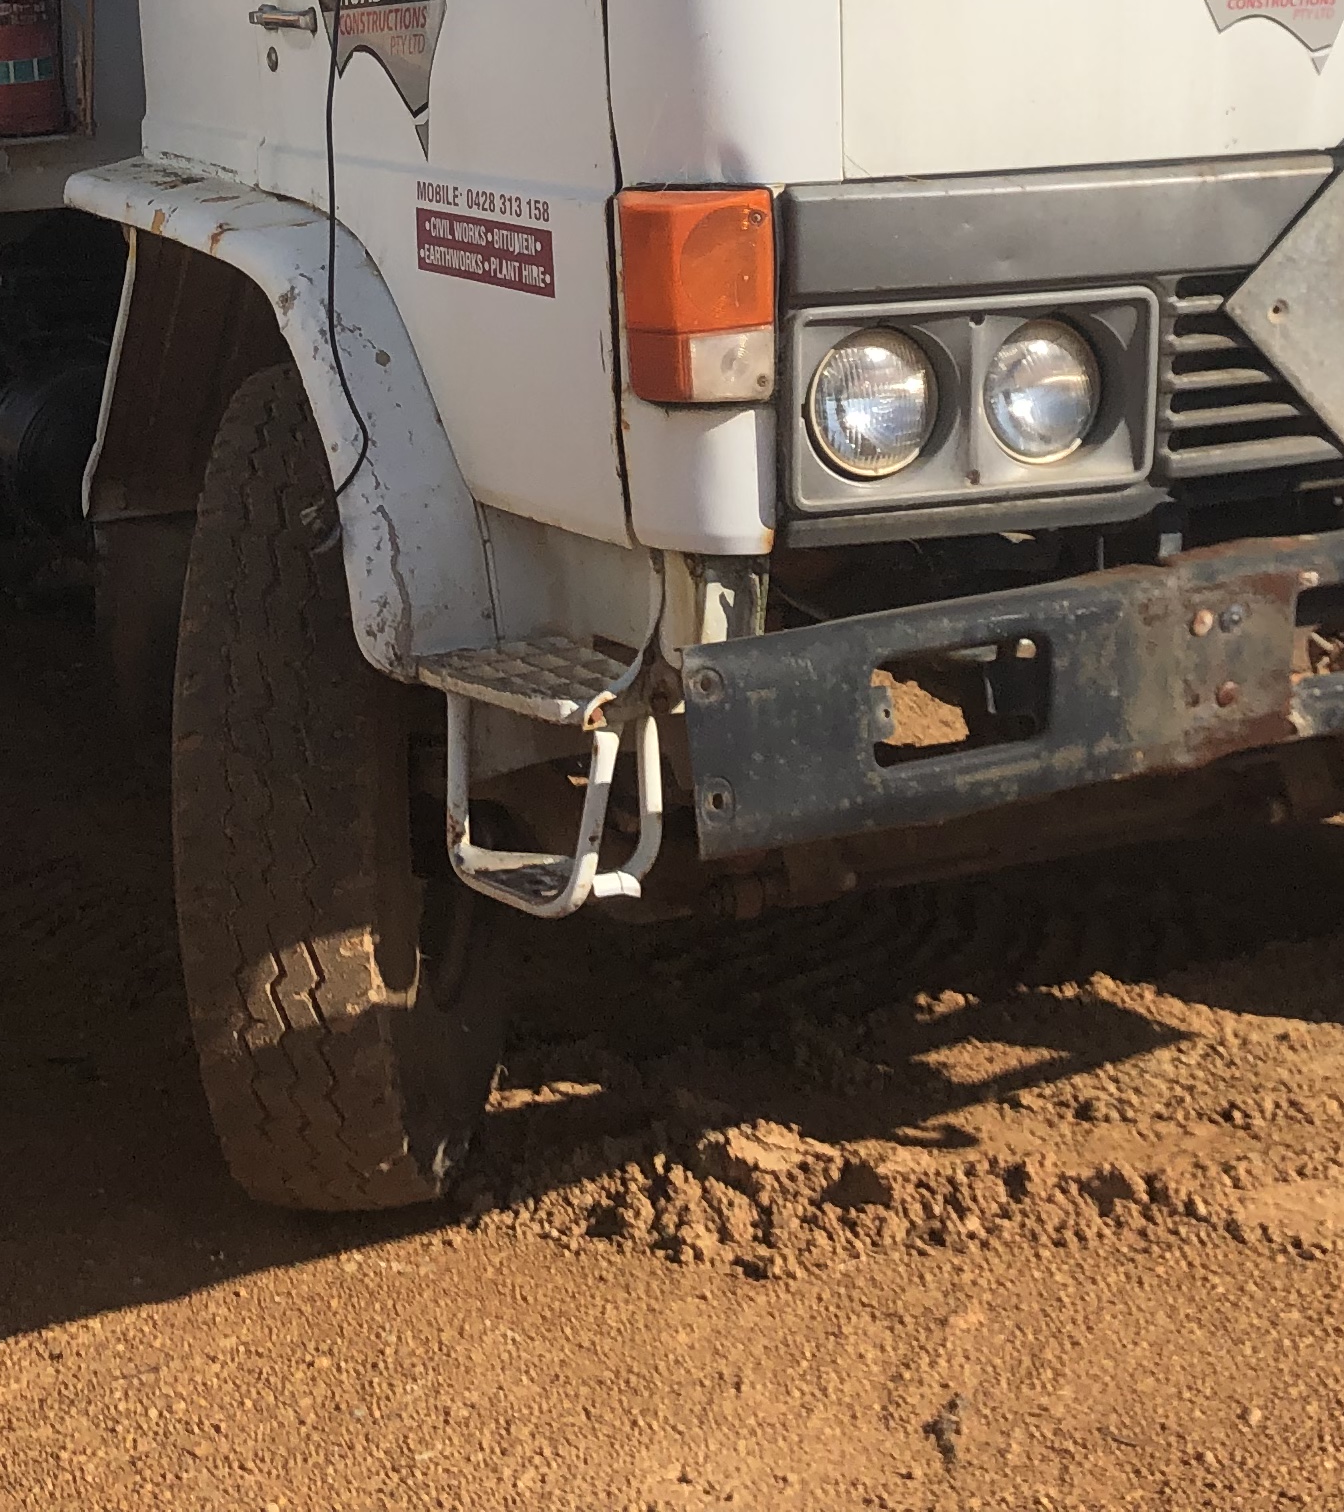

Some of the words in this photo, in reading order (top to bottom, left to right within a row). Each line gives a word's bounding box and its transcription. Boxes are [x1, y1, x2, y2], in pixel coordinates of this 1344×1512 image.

[339, 5, 427, 36] CONSTRUCTIONS
[390, 34, 408, 56] PTY
[408, 33, 426, 55] LTD
[466, 188, 496, 213] 0428
[499, 193, 522, 218] 313
[526, 198, 550, 223] 158
[430, 216, 453, 240] CIVIL
[454, 220, 487, 246] WORKS
[424, 243, 483, 275] EARTHWORKS
[490, 256, 520, 282] PLANT
[522, 263, 546, 288] HIRE
